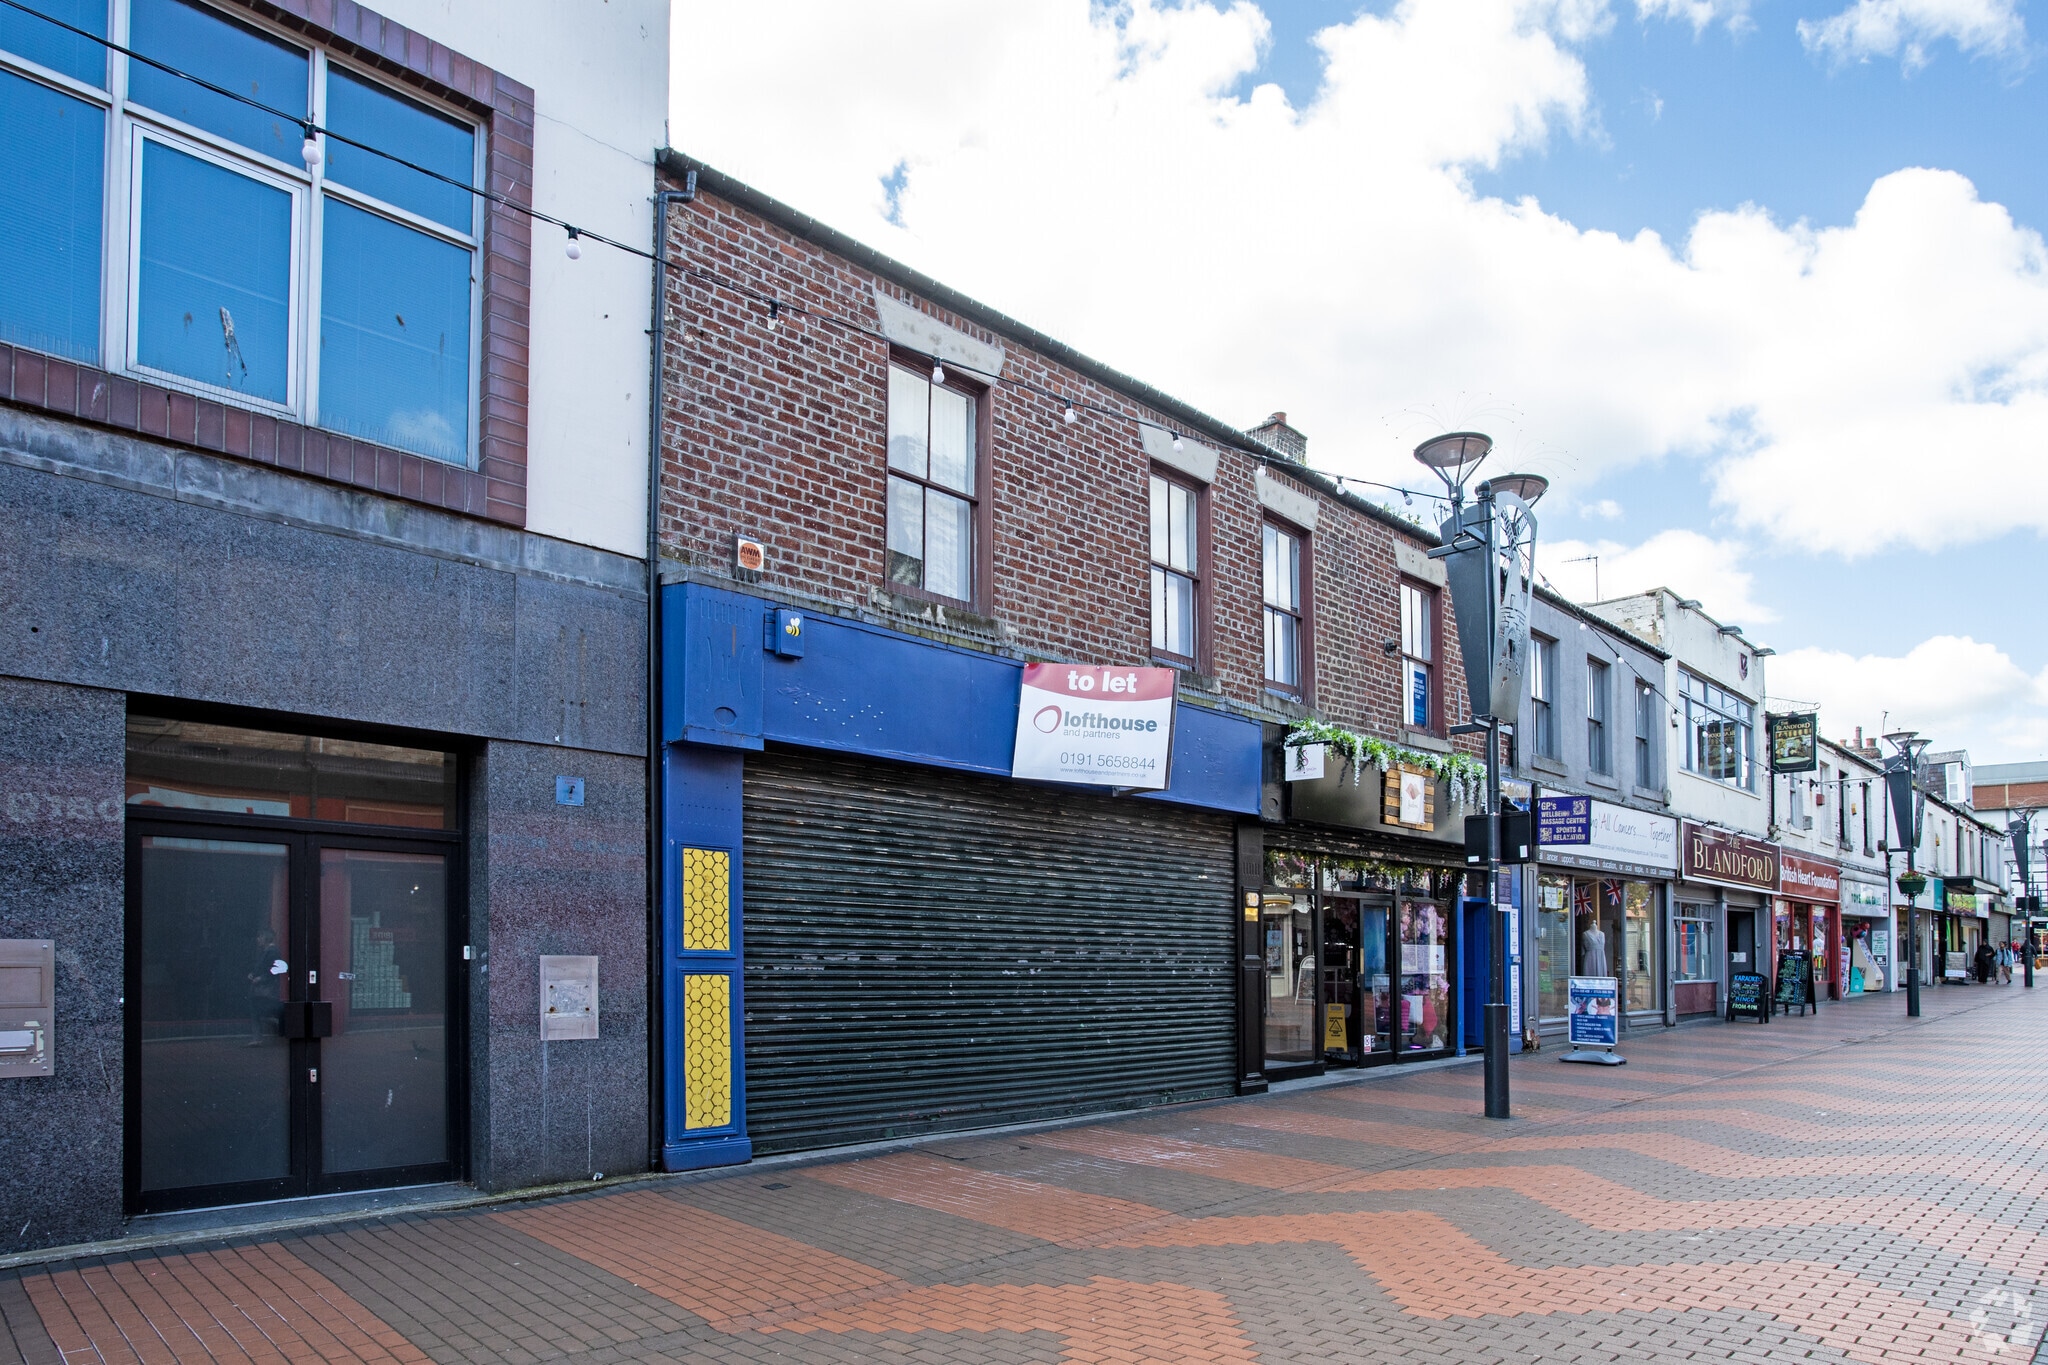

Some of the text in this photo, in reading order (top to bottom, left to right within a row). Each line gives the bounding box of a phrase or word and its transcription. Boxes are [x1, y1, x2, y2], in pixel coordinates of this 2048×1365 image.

[740, 546, 760, 557] AWM
[1067, 670, 1138, 694] to let
[1064, 711, 1158, 732] lofthouse
[1776, 722, 1810, 730] BLANDFORD
[1063, 728, 1120, 740] and partners
[1060, 752, 1155, 770] 0191 5658844
[1693, 838, 1773, 882] BLANDFORD
[1781, 865, 1838, 890] British Heart Foundation
